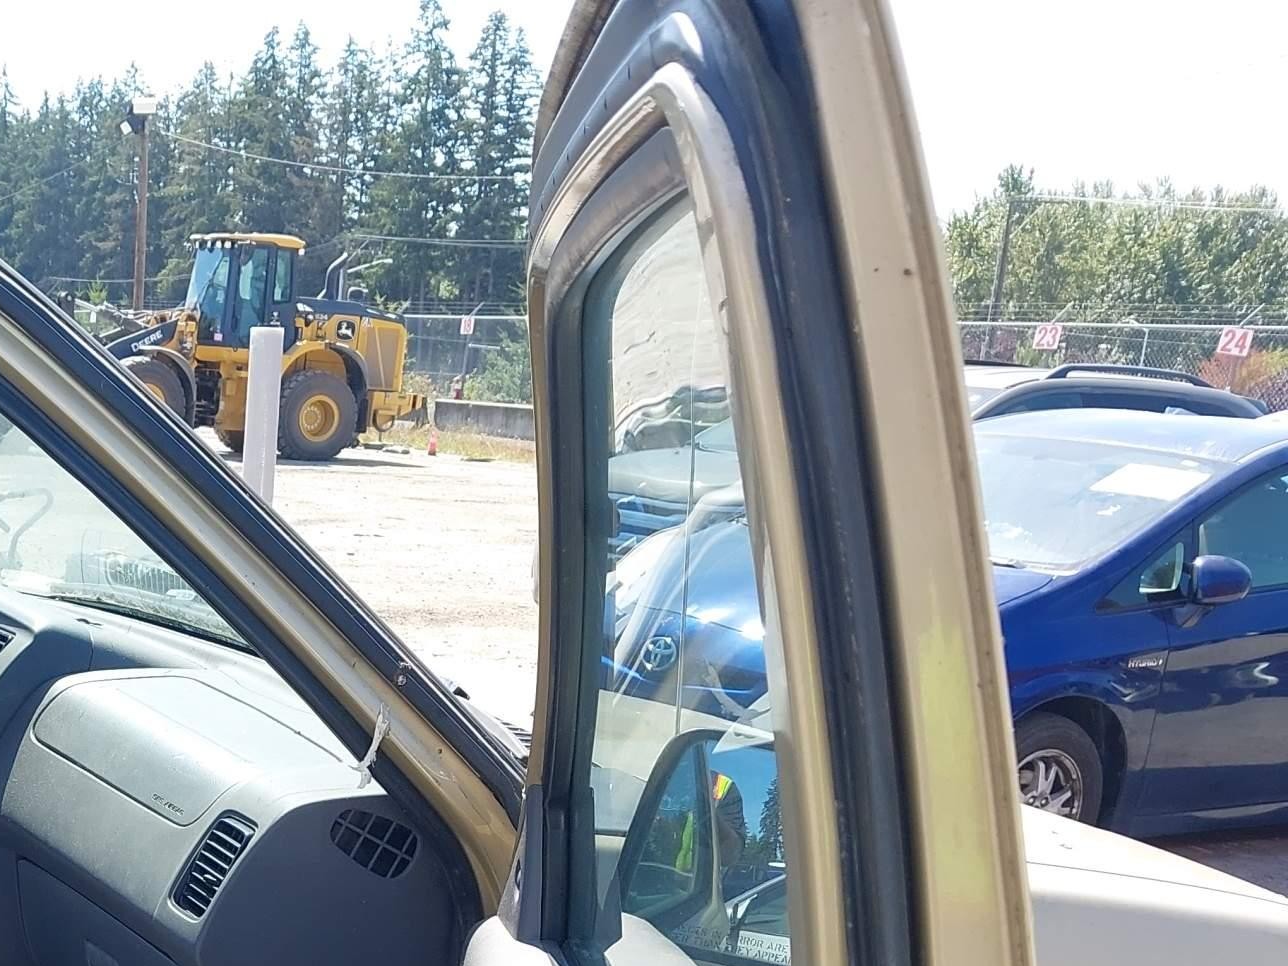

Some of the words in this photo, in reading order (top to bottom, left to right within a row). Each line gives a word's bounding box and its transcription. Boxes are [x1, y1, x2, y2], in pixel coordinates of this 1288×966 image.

[130, 330, 163, 352] DEERE
[1034, 326, 1058, 347] 23
[1220, 329, 1249, 354] 24
[739, 935, 764, 949] RROR
[767, 941, 788, 954] ARE
